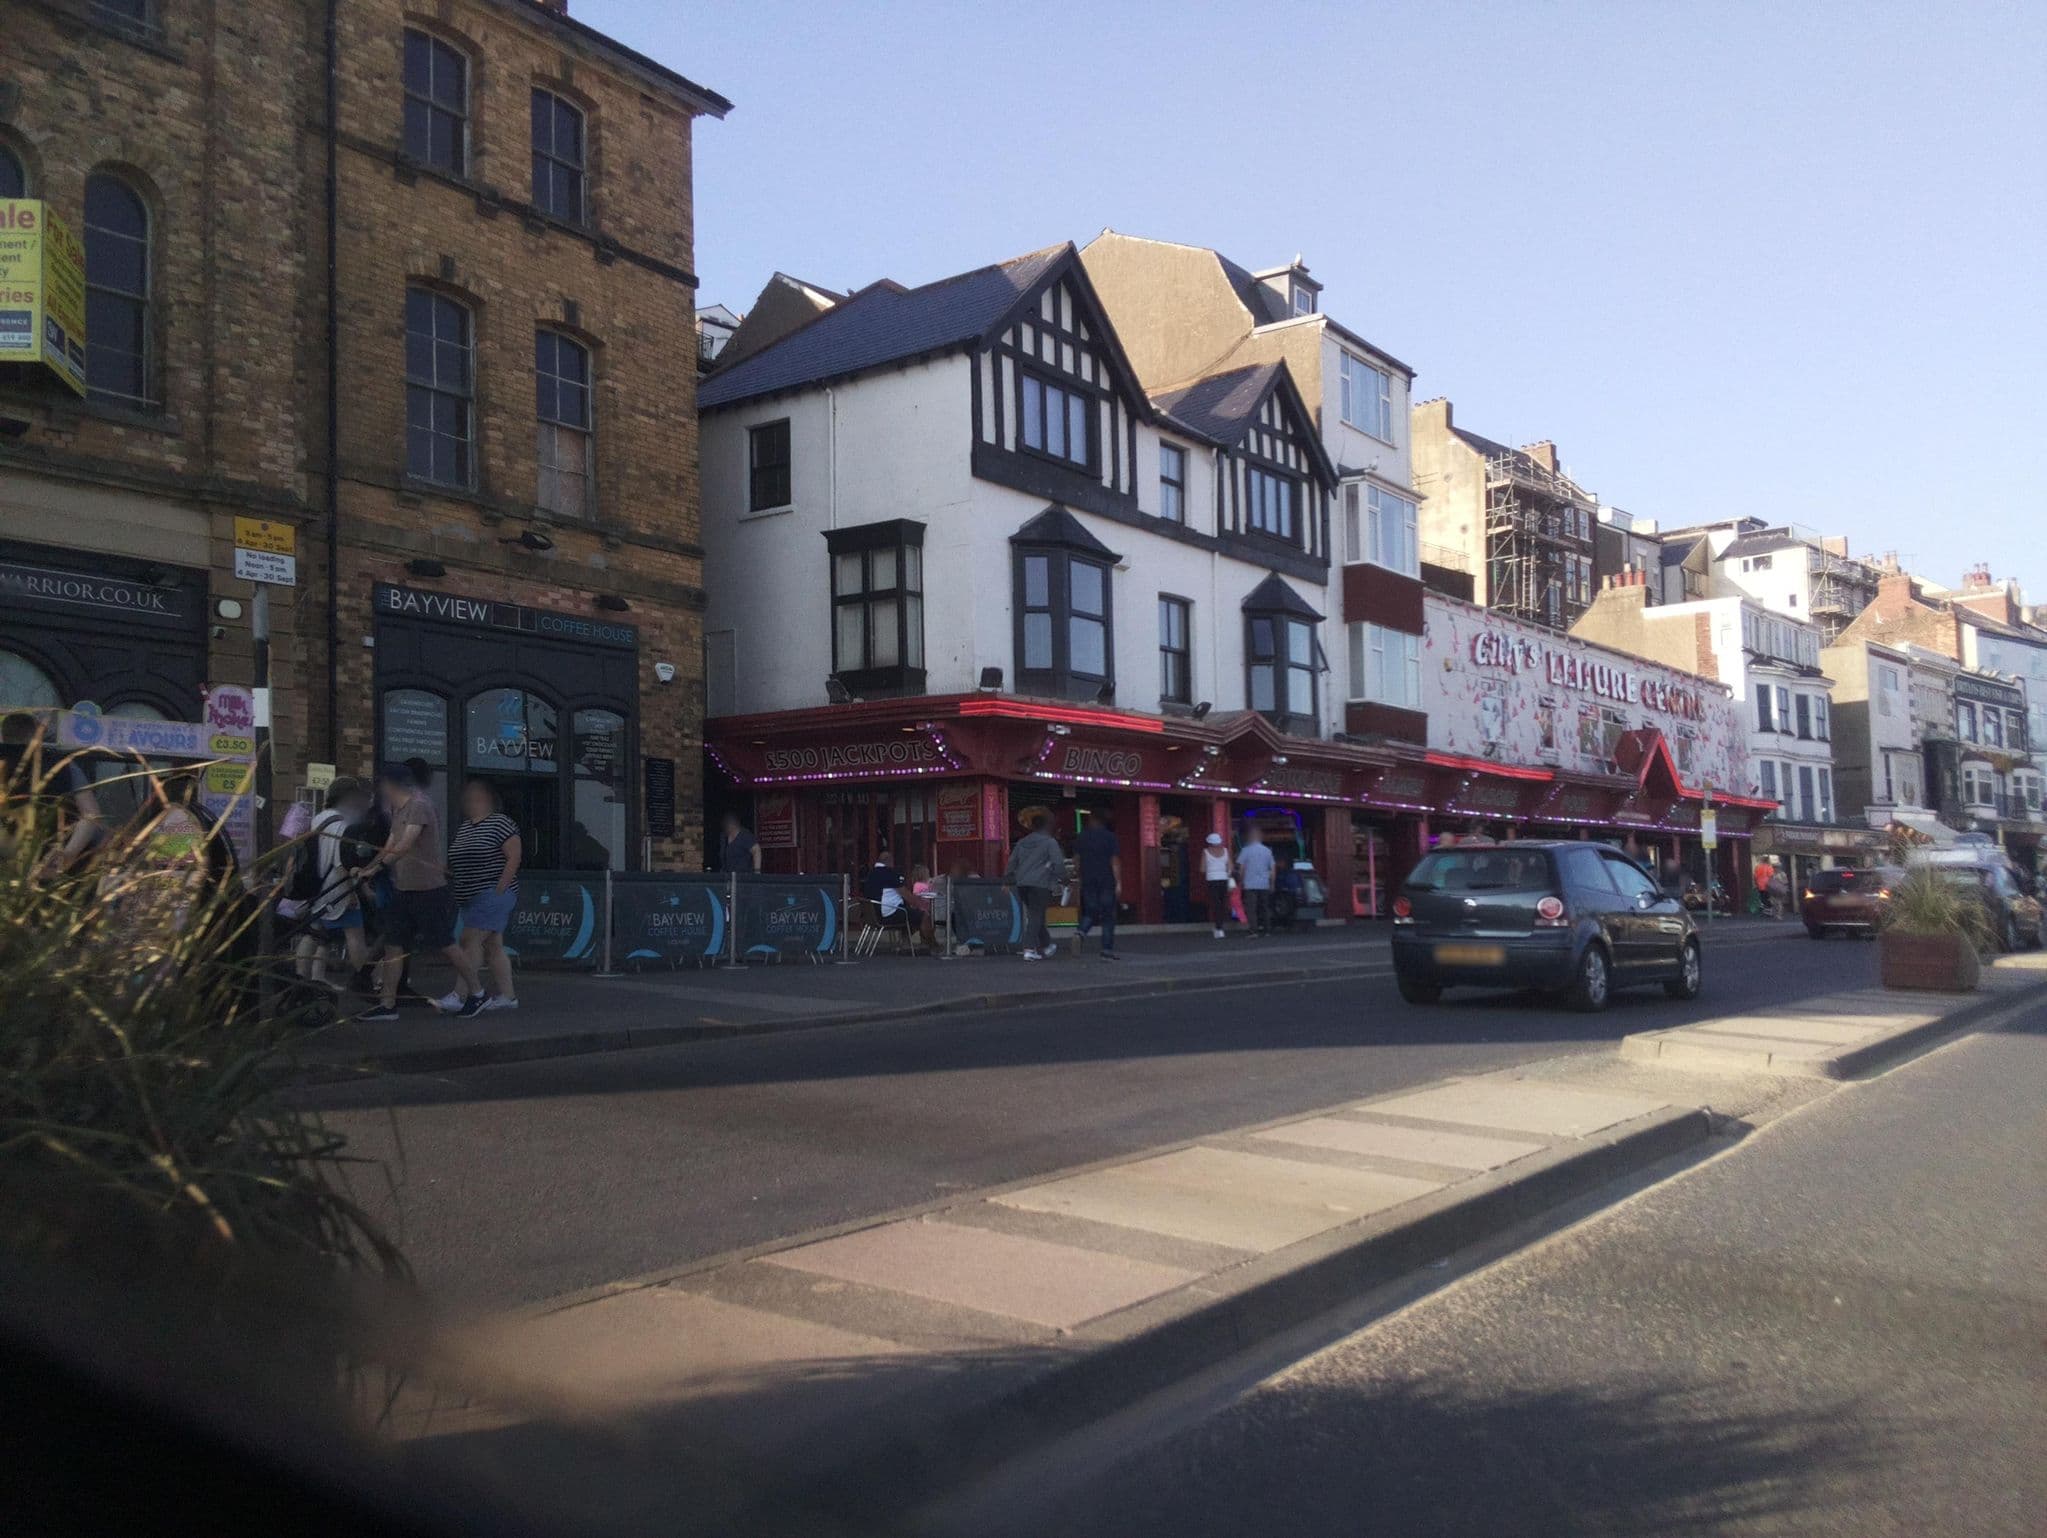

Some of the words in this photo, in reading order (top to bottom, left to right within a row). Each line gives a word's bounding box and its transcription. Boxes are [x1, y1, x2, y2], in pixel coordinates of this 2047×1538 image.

[0, 572, 165, 610] RRIOR.CO.UK
[390, 588, 488, 622] BAYVIEW
[540, 615, 591, 638] COFFEE
[592, 622, 633, 644] HOUSE
[216, 738, 247, 751] £3.50
[477, 736, 554, 759] BAYVIEW
[766, 749, 819, 769] £500
[820, 741, 937, 769] JACKPOTS
[1063, 746, 1142, 777] BINGO
[518, 911, 574, 927] BAYVIEW
[653, 912, 705, 927] BAYVIEW
[770, 911, 819, 924] BAYVIEW
